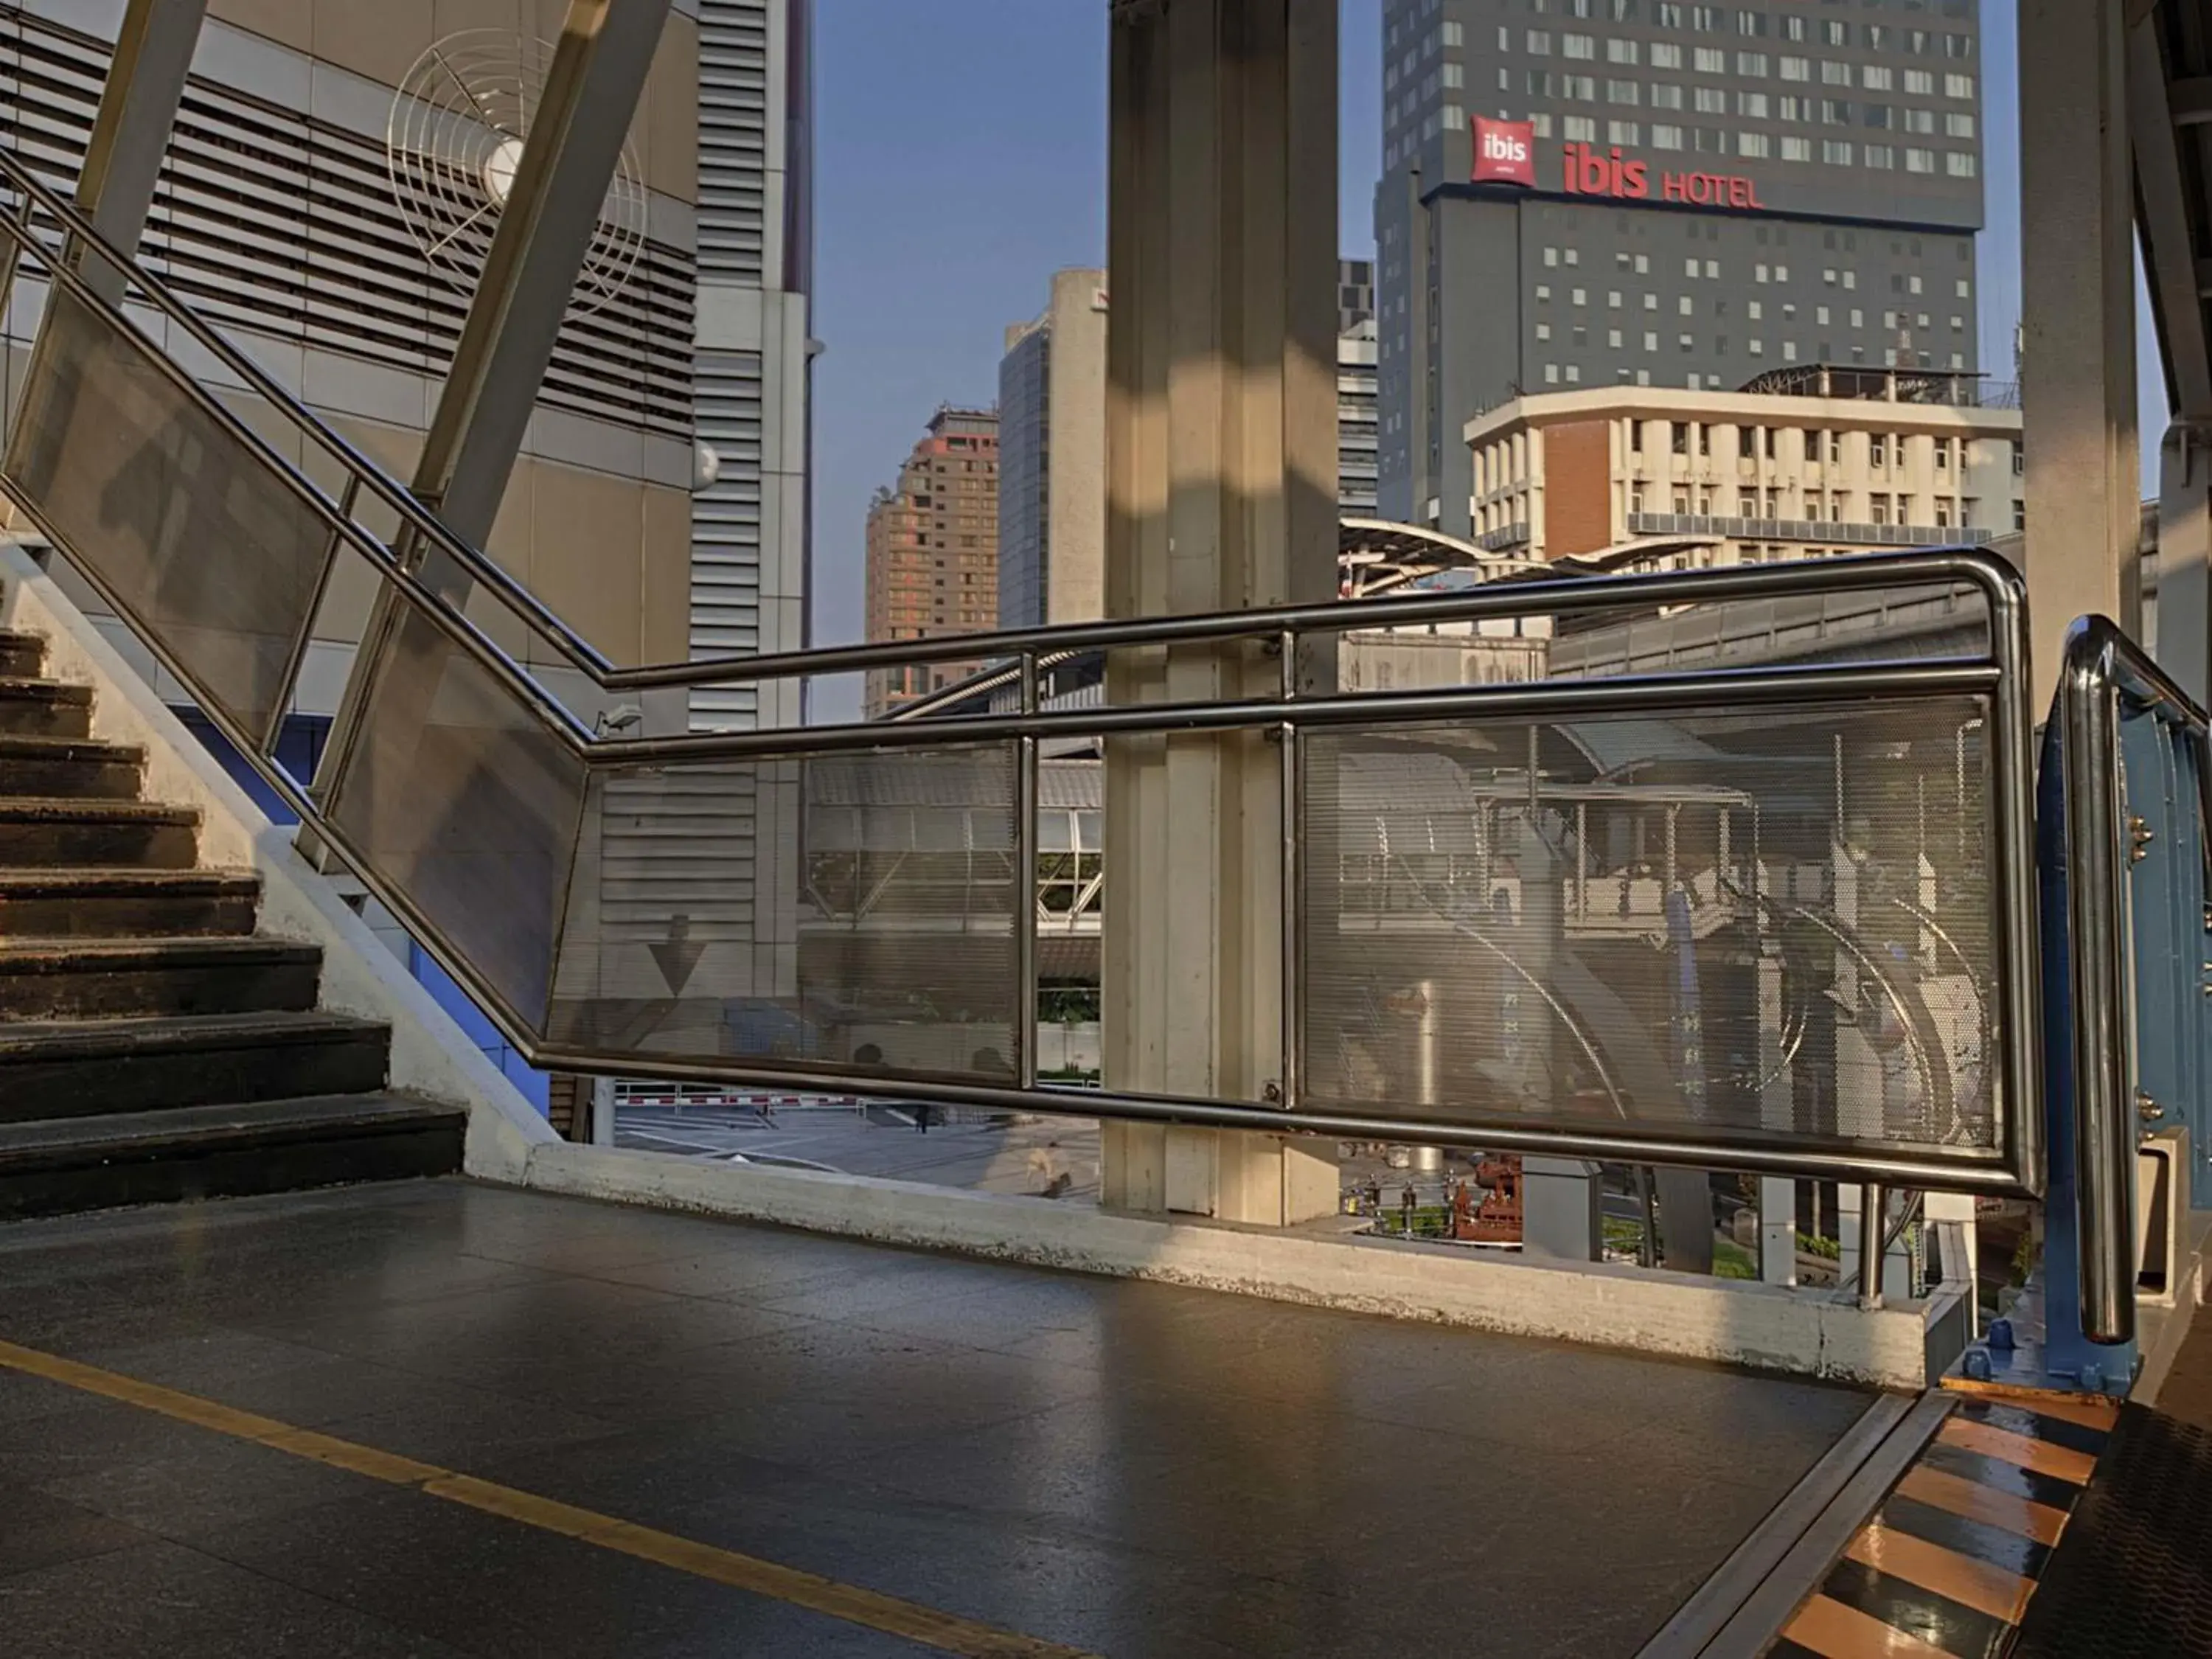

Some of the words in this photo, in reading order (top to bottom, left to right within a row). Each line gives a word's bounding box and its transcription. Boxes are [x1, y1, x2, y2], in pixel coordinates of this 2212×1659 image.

[1484, 133, 1526, 161] ibis
[1563, 141, 1649, 198] ibis
[1662, 170, 1764, 209] HOTEL
